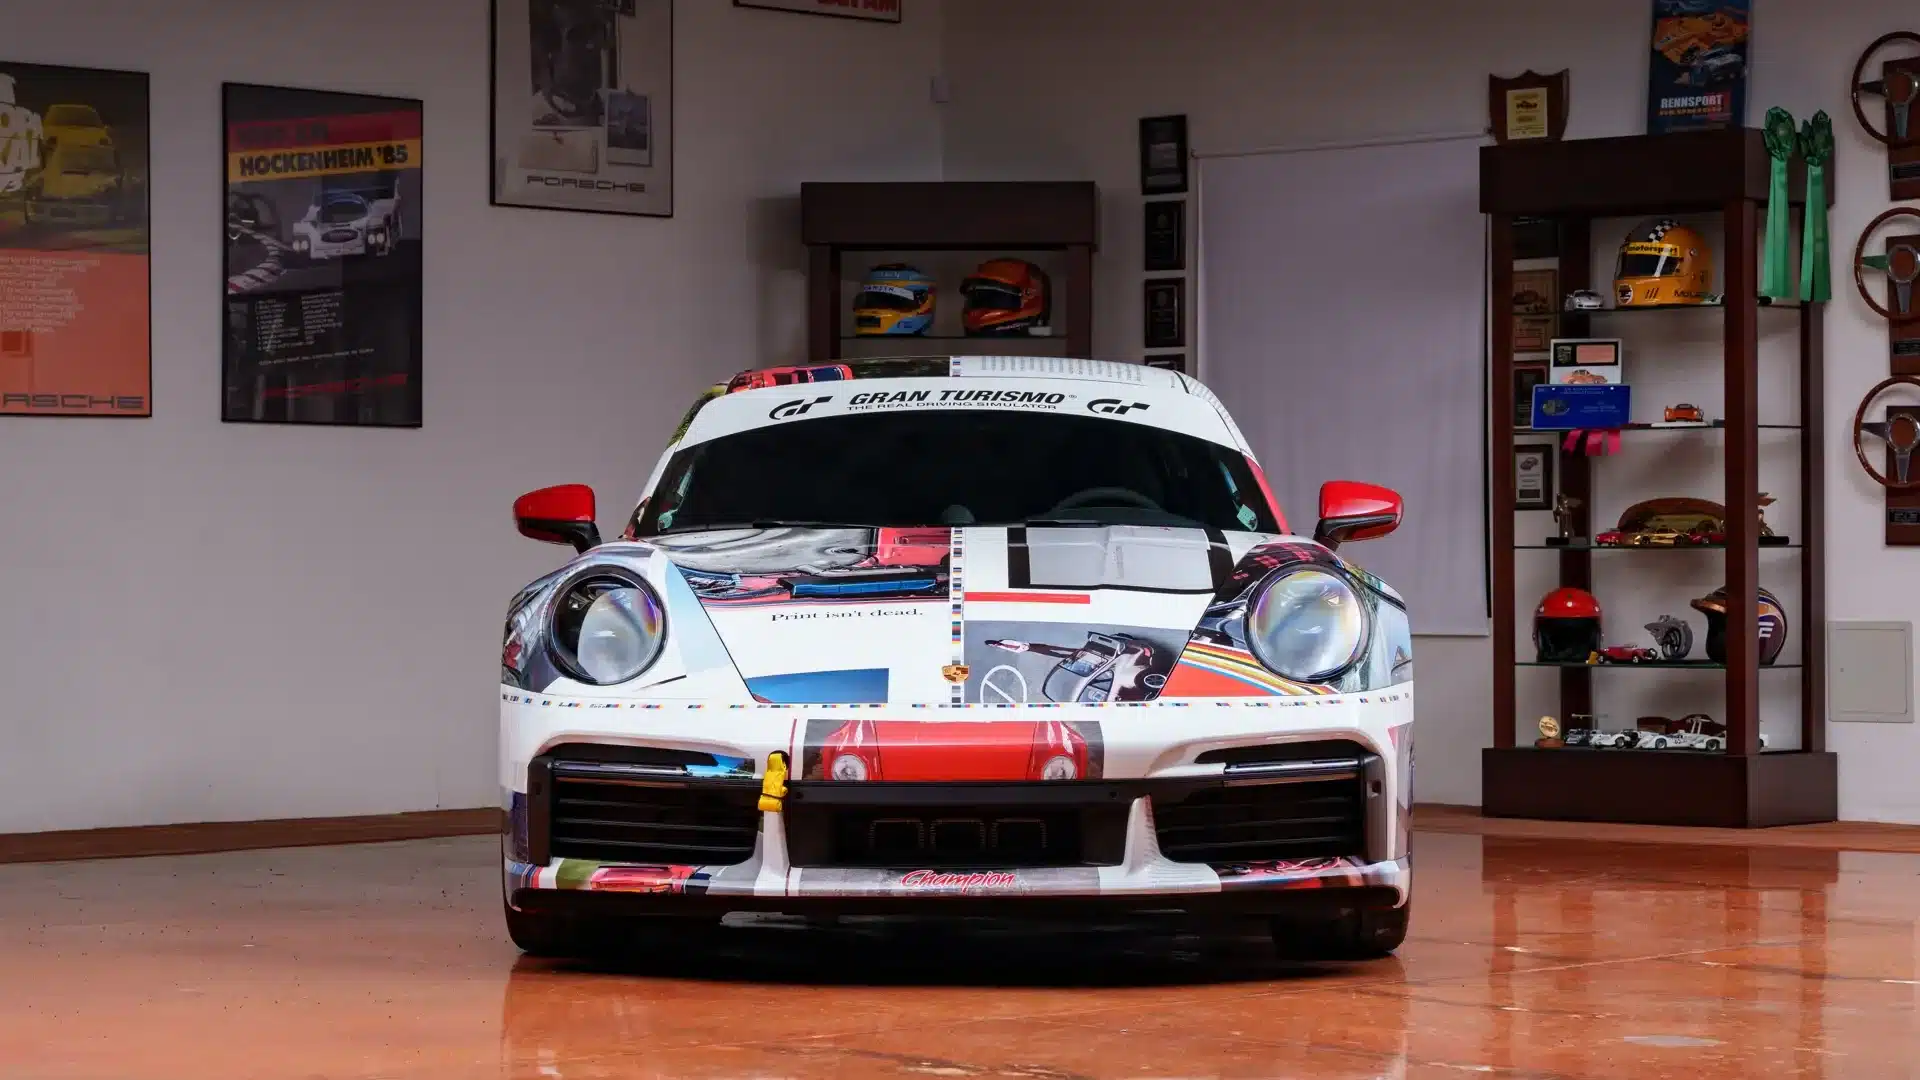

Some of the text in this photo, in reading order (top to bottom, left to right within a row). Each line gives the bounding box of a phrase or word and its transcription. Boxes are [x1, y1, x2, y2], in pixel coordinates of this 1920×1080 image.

[1660, 94, 1724, 109] RENNSPORT
[239, 146, 375, 176] HOCKENHEIM
[527, 175, 645, 192] PORSCHE
[849, 390, 1065, 405] GRAN TURISMO
[771, 608, 923, 621] Print isn't dead.
[901, 869, 1016, 894] Champion
